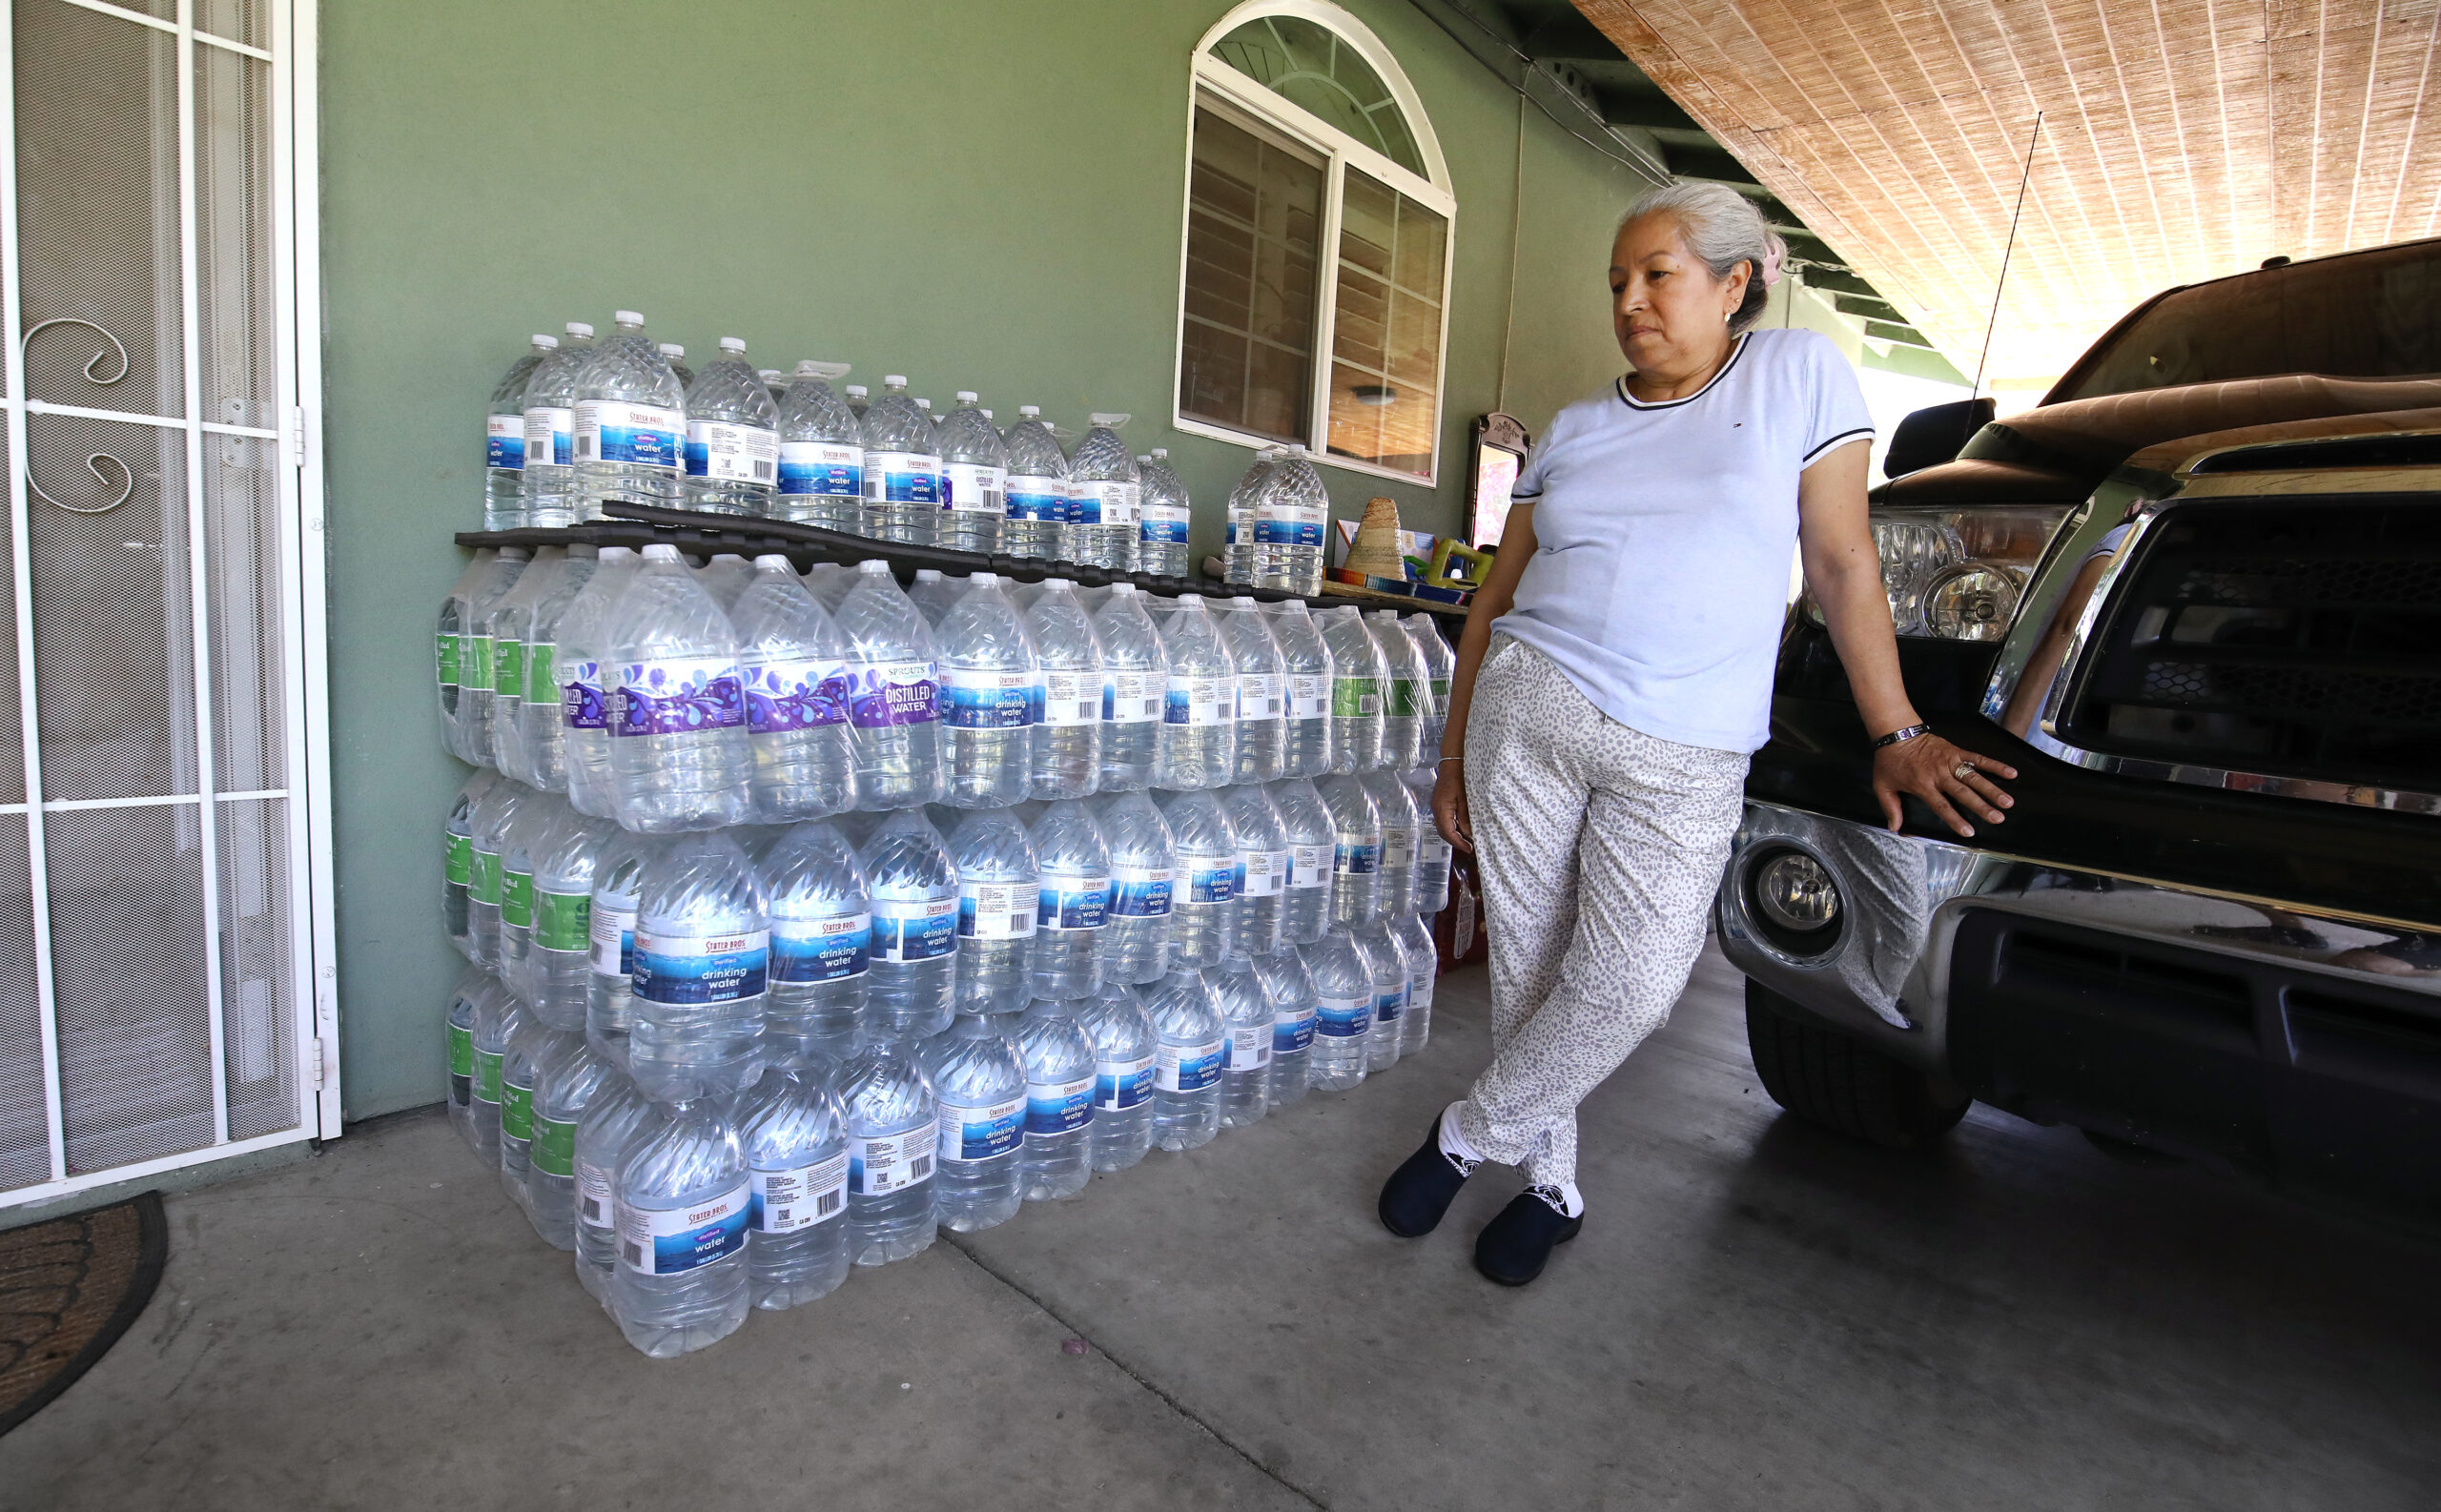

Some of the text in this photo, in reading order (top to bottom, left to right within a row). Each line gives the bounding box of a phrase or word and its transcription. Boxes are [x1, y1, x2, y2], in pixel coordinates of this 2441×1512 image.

[634, 443, 662, 453] water
[829, 477, 851, 485] water
[888, 666, 925, 676] SPROUTS
[885, 685, 930, 704] DISTILLED
[892, 702, 927, 713] WATER
[995, 698, 1026, 708] drinking
[1210, 879, 1232, 888] drinking
[1146, 891, 1169, 900] drinking
[1078, 901, 1105, 910] drinking
[923, 928, 953, 939] drinking
[706, 941, 728, 953] STATER
[928, 936, 949, 947] water
[819, 947, 857, 959] drinking
[714, 957, 737, 966] purified
[825, 956, 851, 968] water
[702, 968, 748, 980] drinking
[708, 977, 740, 989] water
[1296, 1033, 1309, 1042] water
[1198, 1062, 1220, 1073] drinking
[1200, 1070, 1216, 1079] water
[1133, 1076, 1153, 1090] drinking
[1136, 1085, 1151, 1095] water
[1060, 1102, 1088, 1115] drinking
[1064, 1111, 1084, 1122] water
[986, 1125, 1015, 1140] drinking
[990, 1134, 1012, 1146] water
[688, 1210, 710, 1225] STATER
[699, 1229, 720, 1240] distilled
[694, 1236, 726, 1254] water
